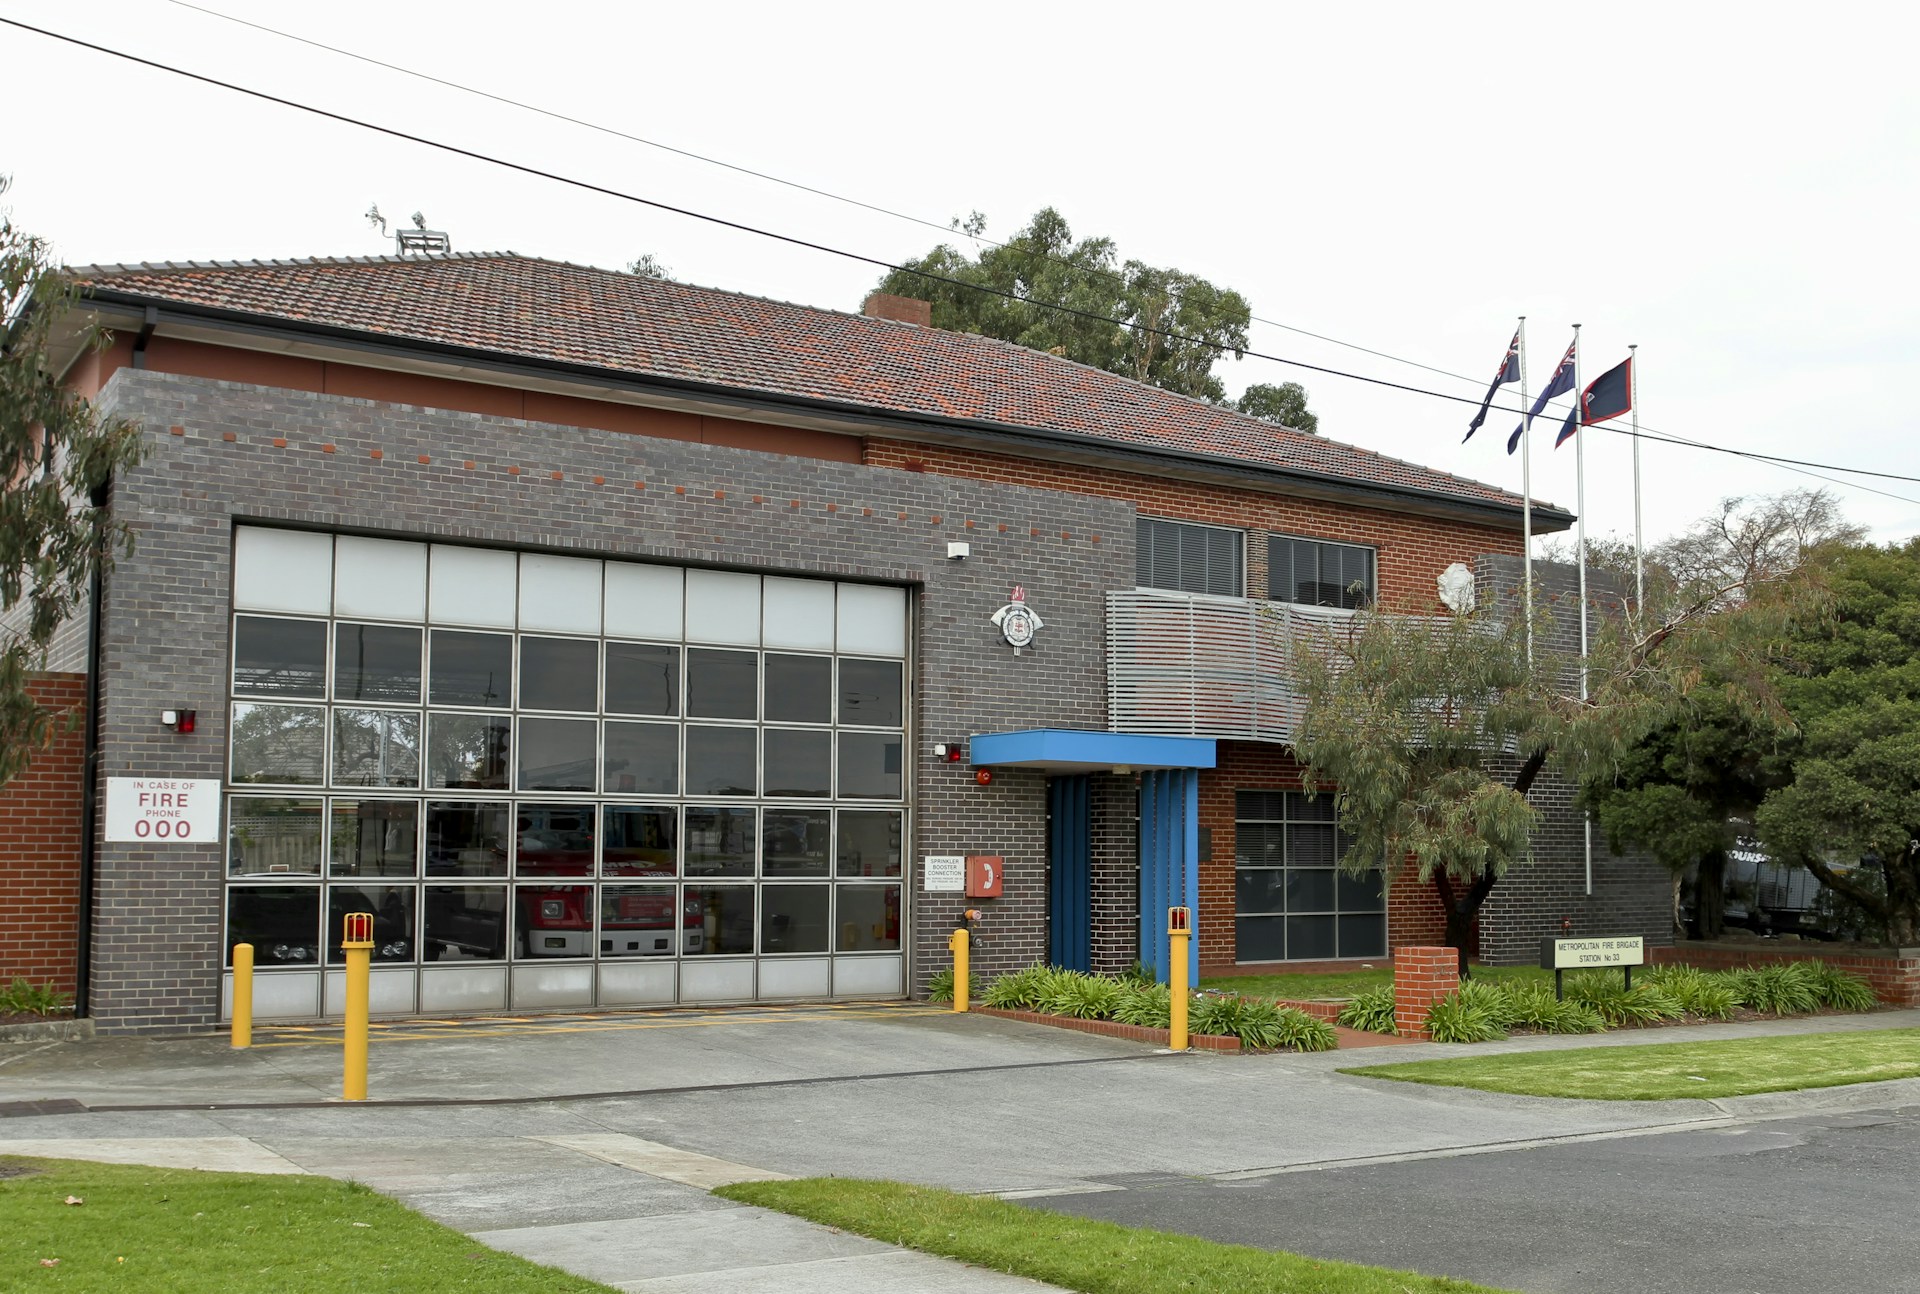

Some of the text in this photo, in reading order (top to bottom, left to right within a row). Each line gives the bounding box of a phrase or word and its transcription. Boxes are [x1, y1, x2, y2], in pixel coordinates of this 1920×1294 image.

[133, 781, 195, 790] IN CASE OF
[139, 793, 188, 807] FIRE
[145, 809, 181, 817] PHONE
[1558, 941, 1639, 951] METROPOLITAN FIRE BRIGADE
[1579, 954, 1601, 963] STATION
[1613, 953, 1620, 961] 33
